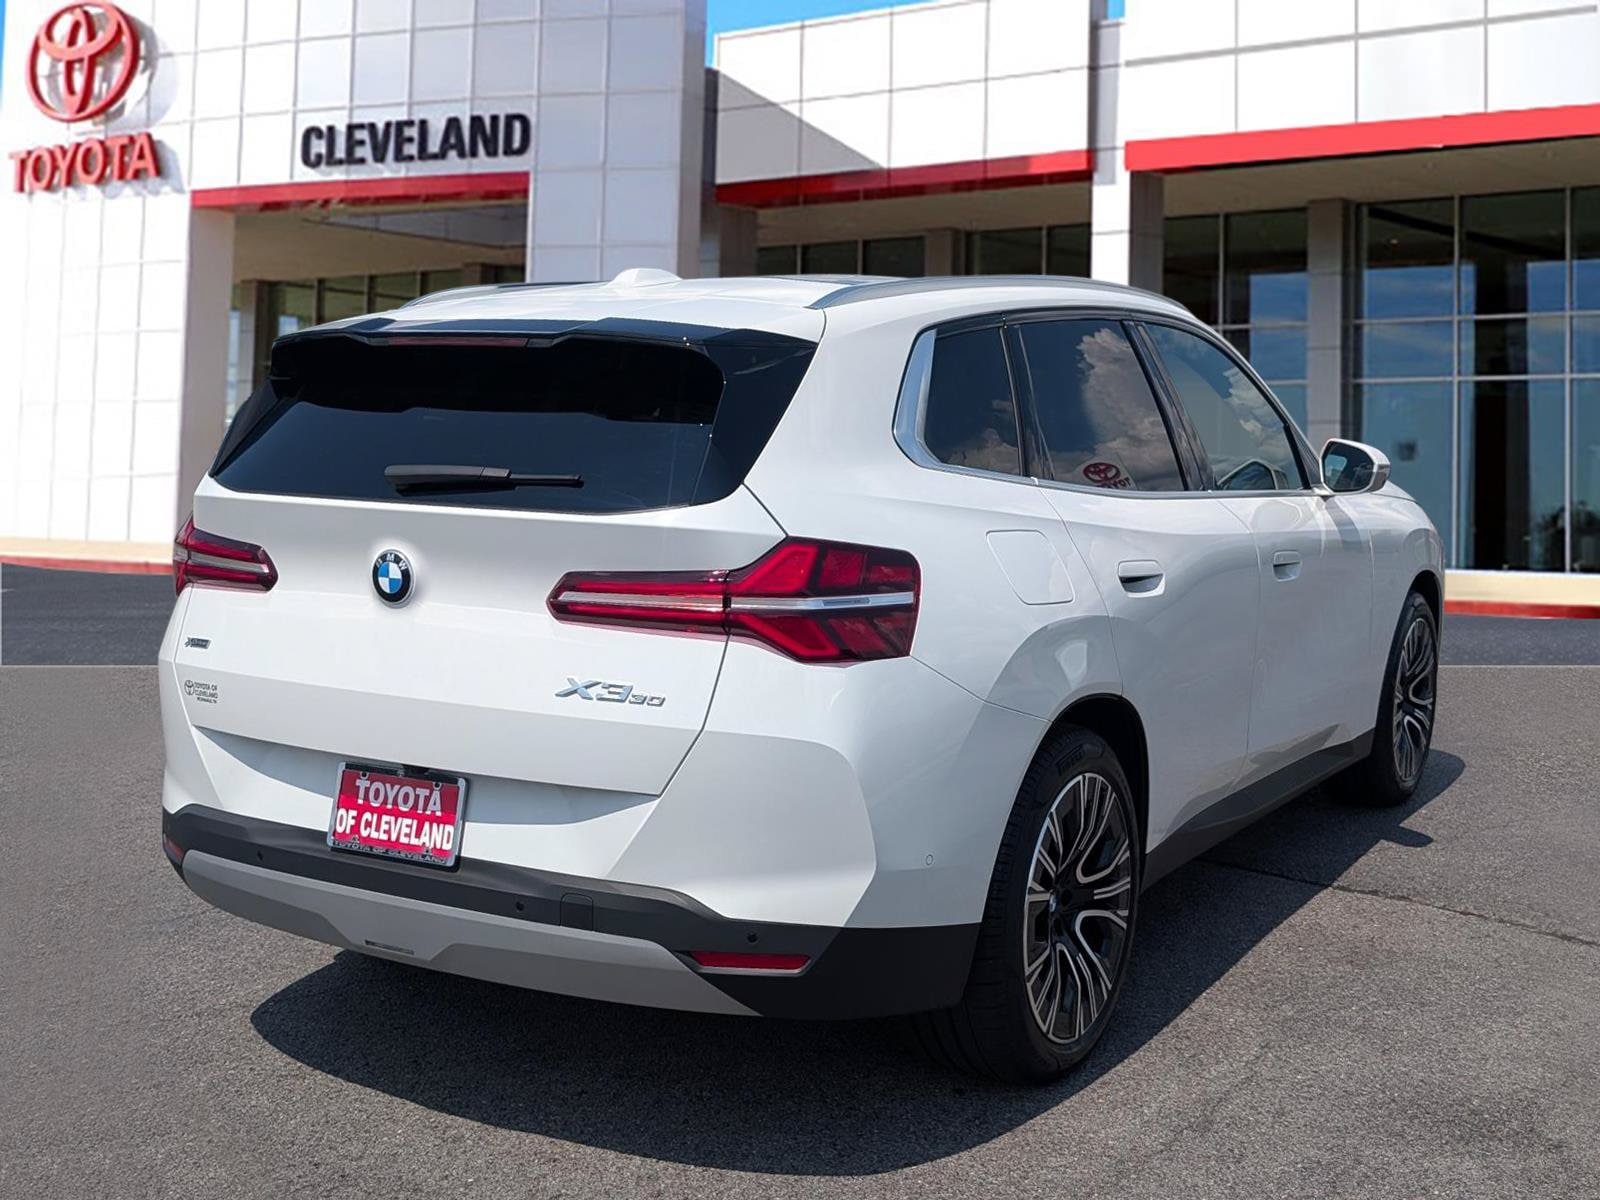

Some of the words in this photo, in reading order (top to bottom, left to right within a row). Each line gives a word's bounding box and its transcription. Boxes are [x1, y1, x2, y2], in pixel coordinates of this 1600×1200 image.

[9, 132, 161, 193] TOYOTA
[301, 113, 531, 170] CLEVELAND
[375, 553, 408, 570] BMW
[356, 780, 442, 816] TOYOTA
[336, 808, 357, 833] OF
[360, 812, 454, 850] CLEVELAND
